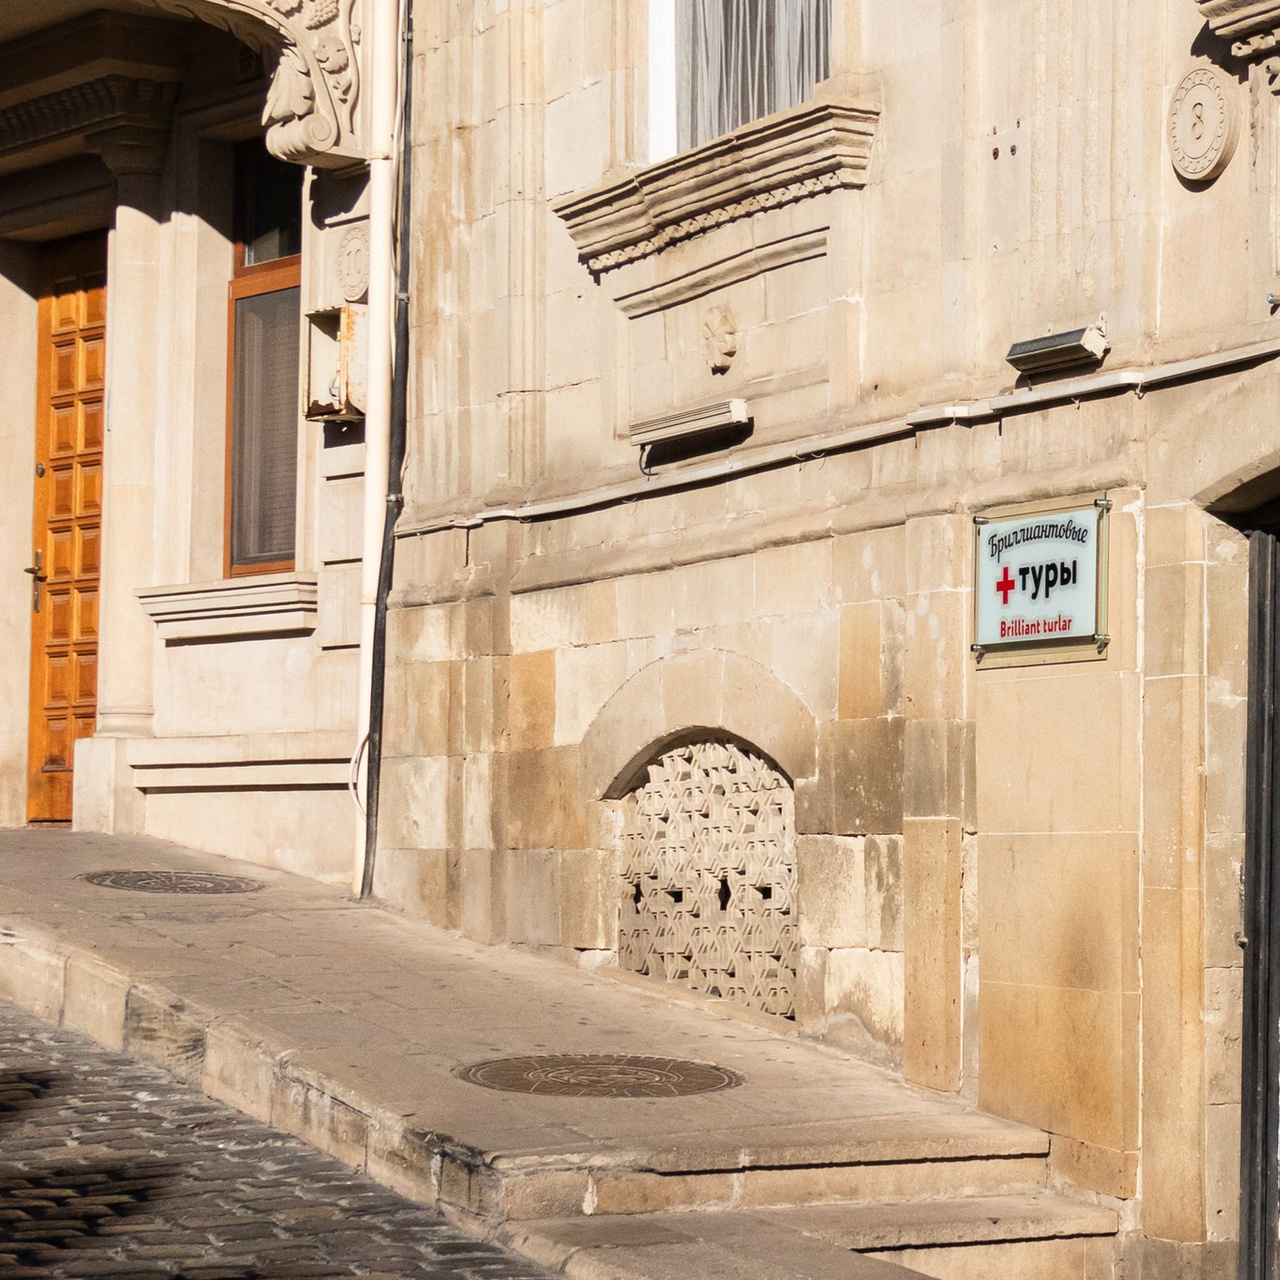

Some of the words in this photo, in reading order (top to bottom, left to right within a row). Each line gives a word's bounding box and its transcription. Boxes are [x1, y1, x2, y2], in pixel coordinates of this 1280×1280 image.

[1191, 102, 1204, 140] 8
[345, 248, 362, 277] 10
[988, 519, 1088, 563] Бриллиантовые
[1018, 559, 1078, 600] туры
[1000, 619, 1041, 638] Brilliant
[1043, 614, 1072, 633] turlar
